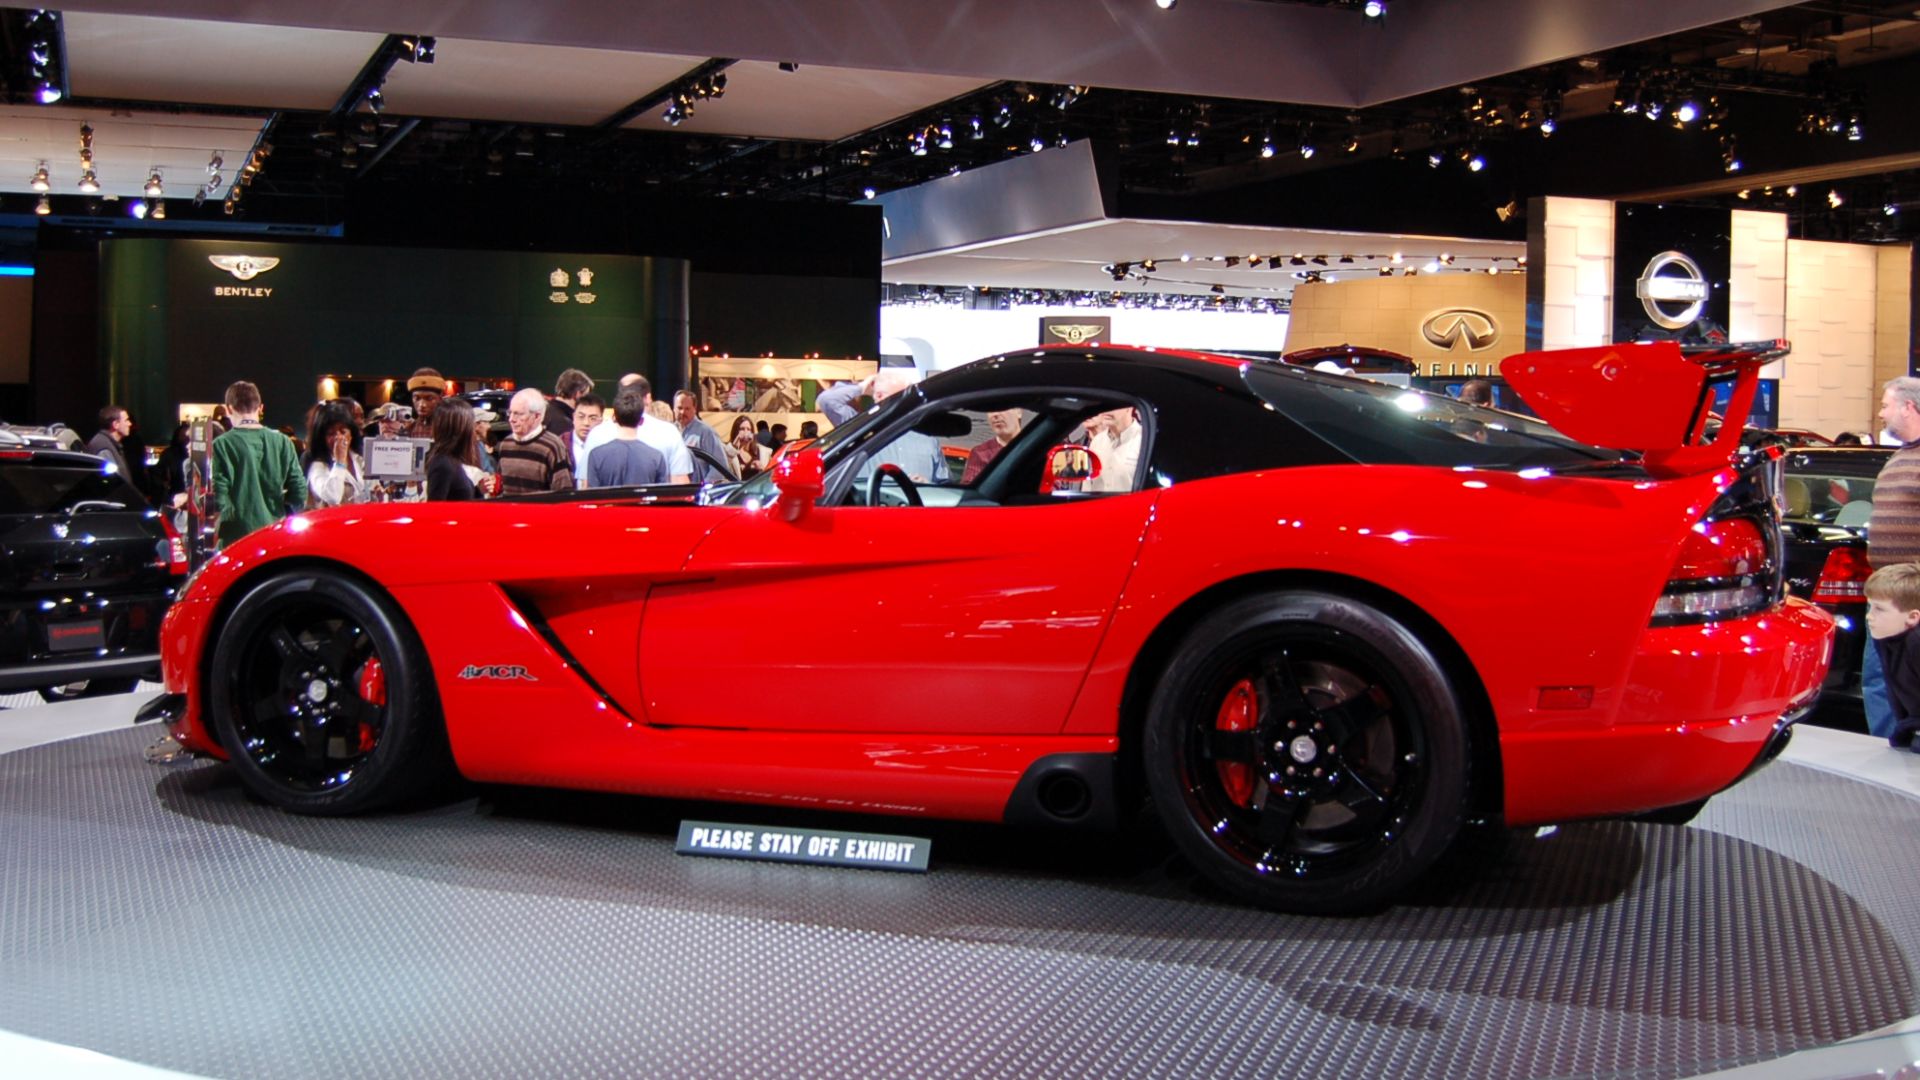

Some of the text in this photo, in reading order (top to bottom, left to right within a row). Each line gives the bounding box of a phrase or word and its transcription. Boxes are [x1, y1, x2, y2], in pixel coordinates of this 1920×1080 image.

[214, 286, 273, 297] BENTLEY
[474, 664, 538, 681] ACR
[690, 827, 915, 863] PLEASE STAY OFF EXHIBIT
